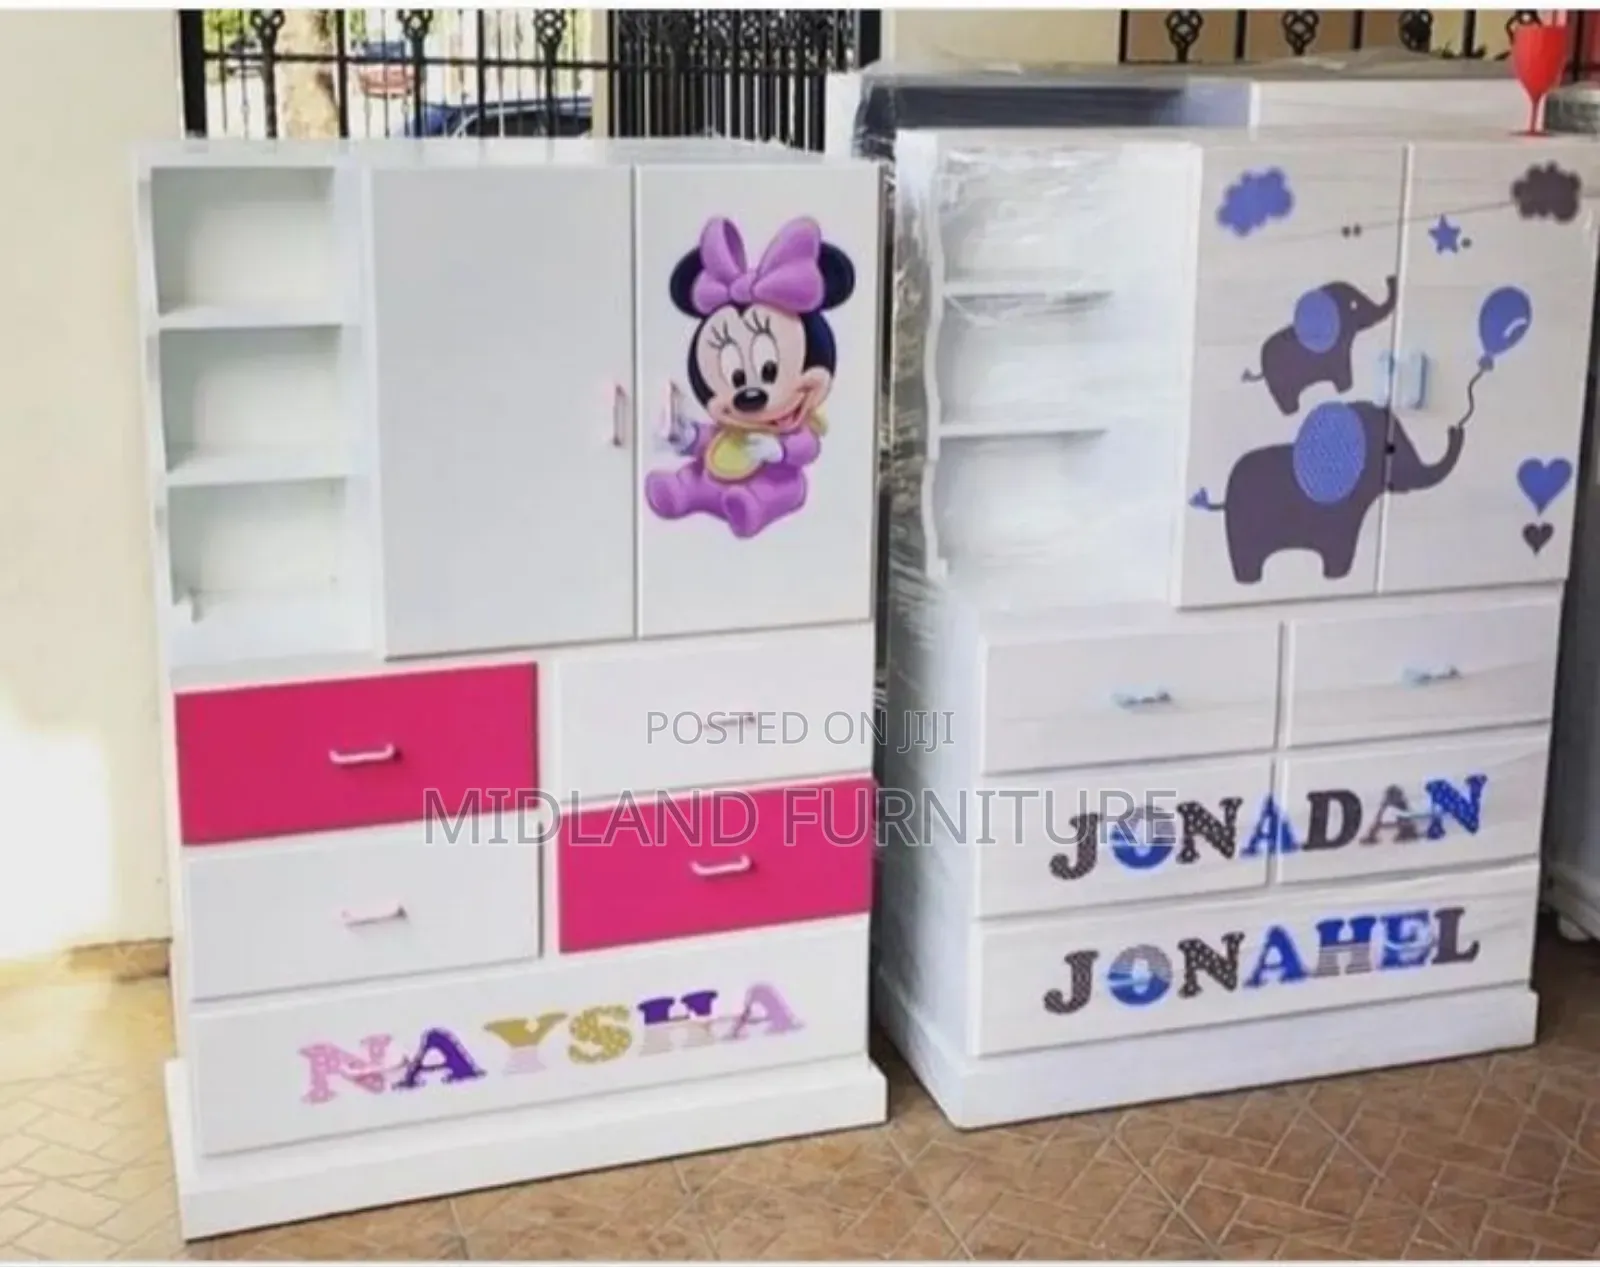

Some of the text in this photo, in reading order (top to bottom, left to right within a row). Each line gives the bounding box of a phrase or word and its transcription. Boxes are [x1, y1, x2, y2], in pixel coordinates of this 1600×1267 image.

[1049, 775, 1487, 880] JONADAN
[1043, 907, 1479, 1015] JONAHEL
[299, 983, 804, 1104] NAYSHA
